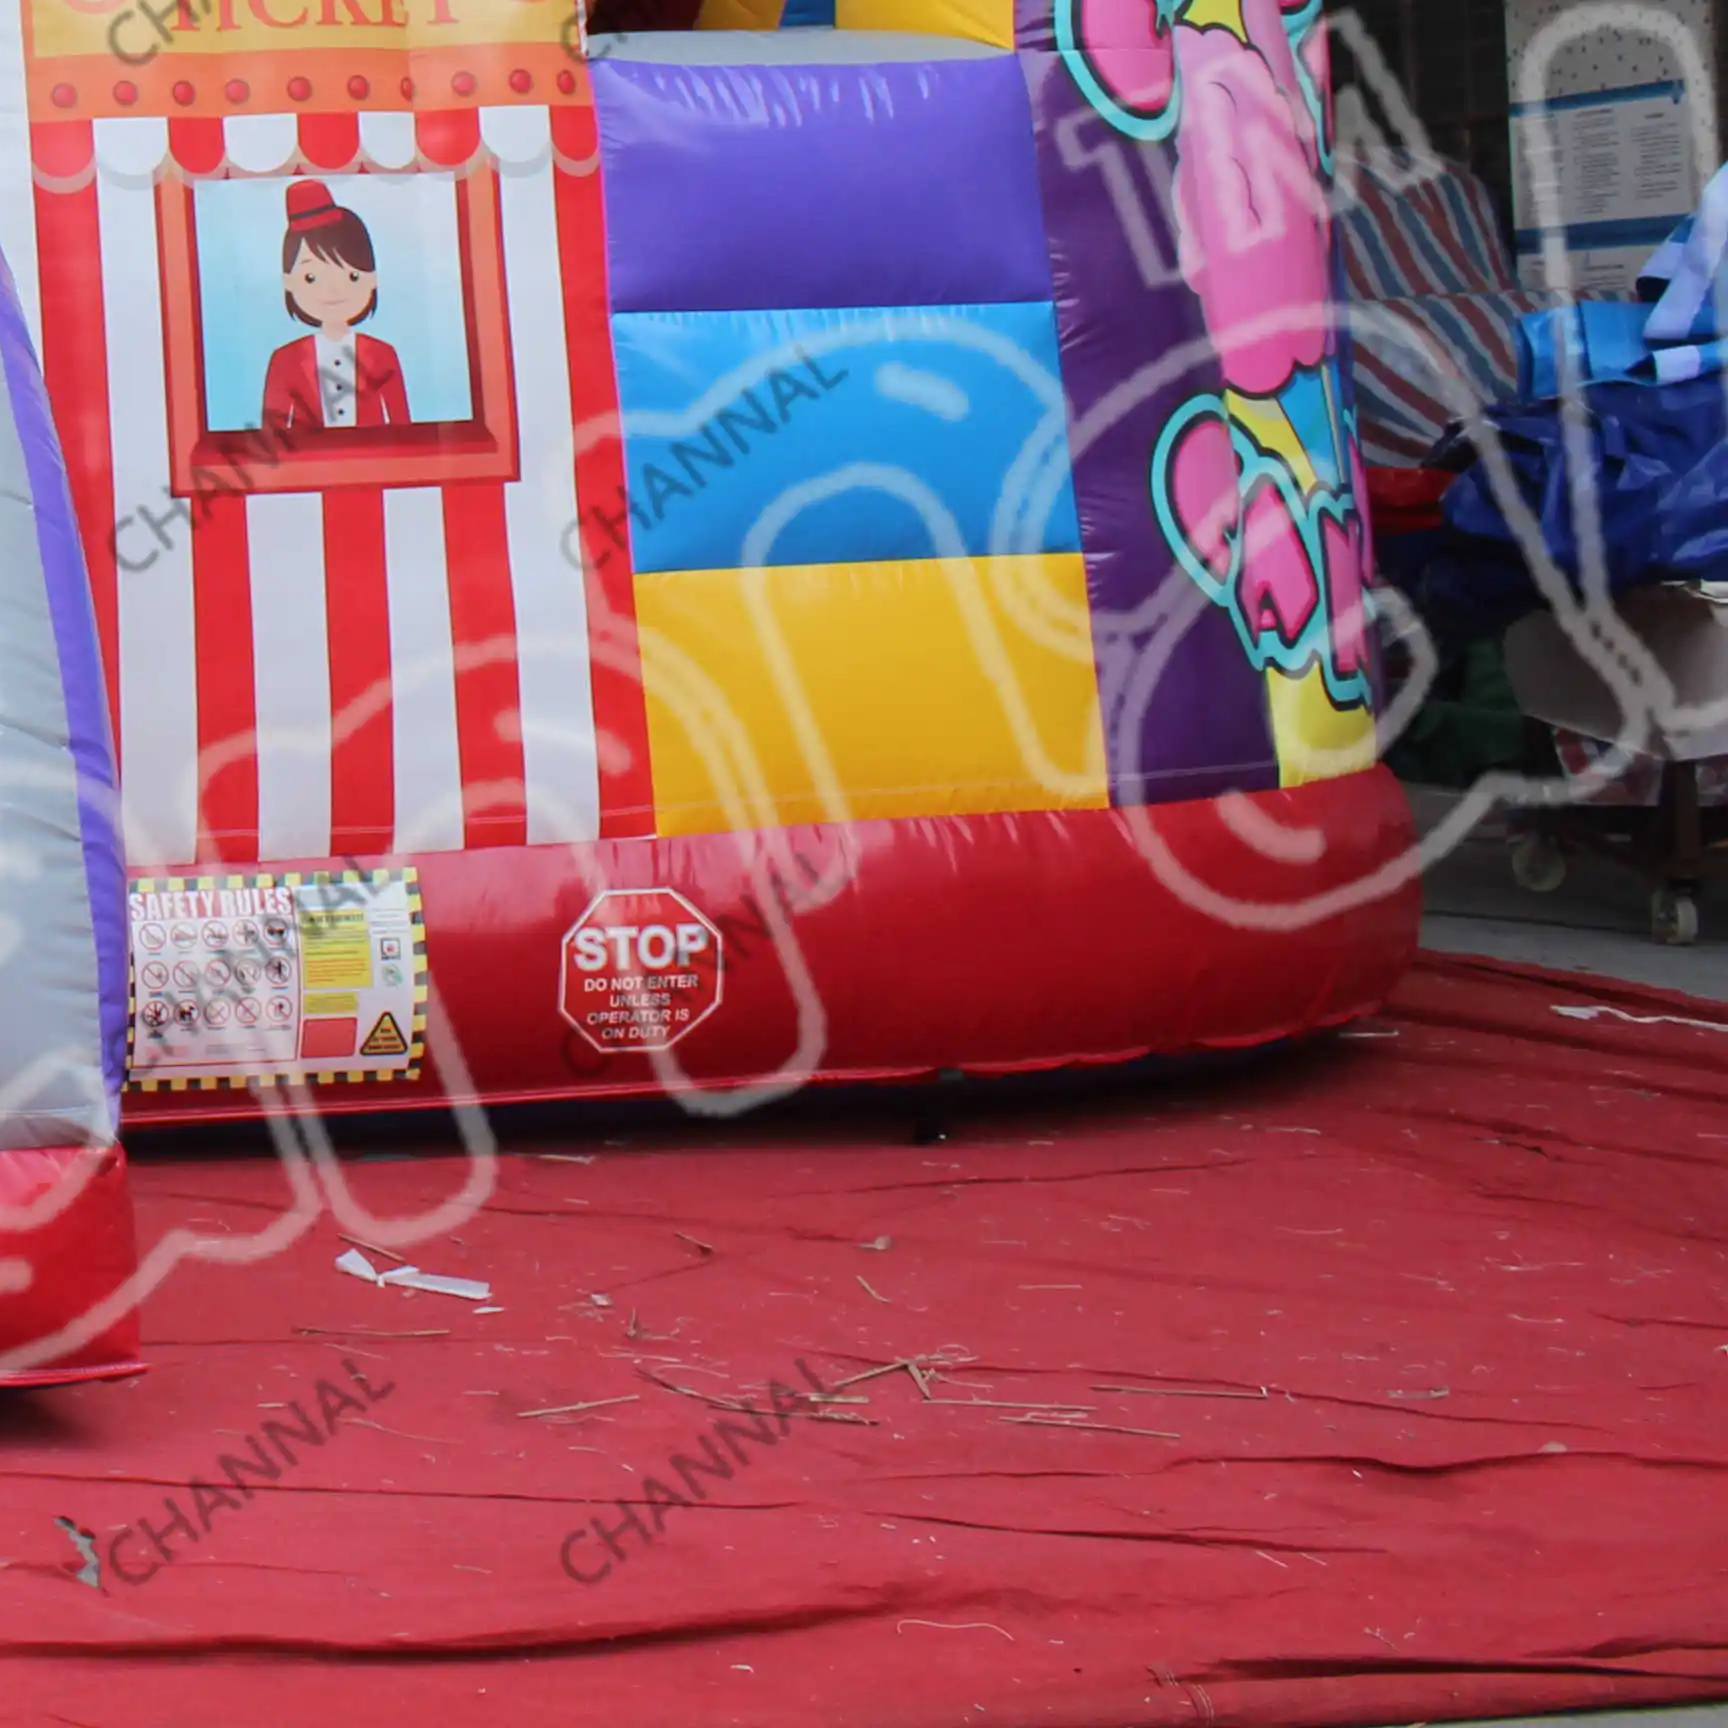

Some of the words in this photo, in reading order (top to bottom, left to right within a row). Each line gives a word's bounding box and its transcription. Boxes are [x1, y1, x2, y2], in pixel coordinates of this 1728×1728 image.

[129, 889, 214, 921] SAFETY
[221, 886, 292, 917] RULES
[573, 923, 709, 972] STOP
[584, 978, 607, 992] DO
[611, 977, 643, 991] NOT
[647, 974, 698, 989] ENTER
[610, 993, 671, 1007] UNLESS
[587, 1009, 671, 1025] OPERATOR
[675, 1008, 690, 1022] IS
[601, 1027, 625, 1040] ON
[629, 1024, 672, 1040] DUTY
